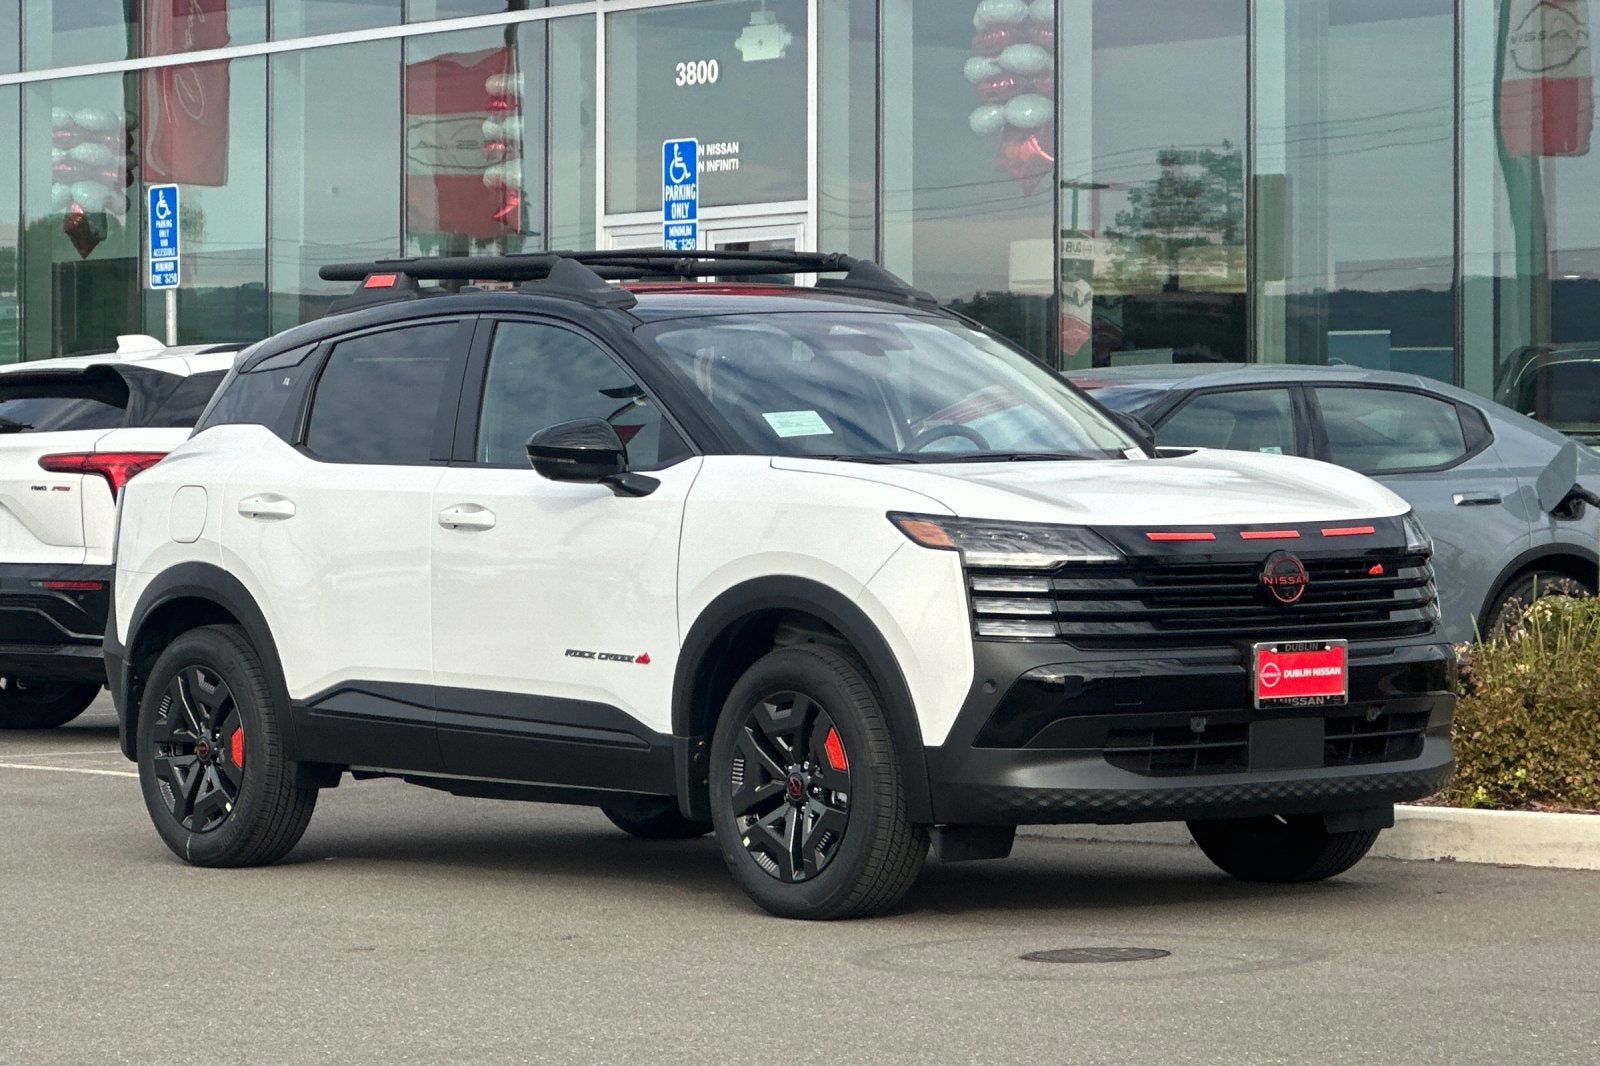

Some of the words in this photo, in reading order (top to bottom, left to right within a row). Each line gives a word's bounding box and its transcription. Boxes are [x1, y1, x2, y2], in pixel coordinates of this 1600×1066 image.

[675, 59, 718, 86] 3800
[706, 142, 739, 155] NISSAN
[706, 158, 739, 172] INFINITI
[665, 184, 696, 201] PARKING
[671, 202, 690, 219] ONLY
[155, 219, 172, 228] PARKING
[159, 229, 169, 238] ONLY
[669, 225, 692, 237] MINIMUM
[665, 239, 677, 250] FINE
[1262, 575, 1309, 585] NISSAN
[1284, 642, 1319, 652] DUBLIN
[565, 649, 597, 660] ROCK
[597, 652, 635, 663] CREEK
[1283, 668, 1312, 679] DUBLIN
[1312, 666, 1342, 678] NISSAN
